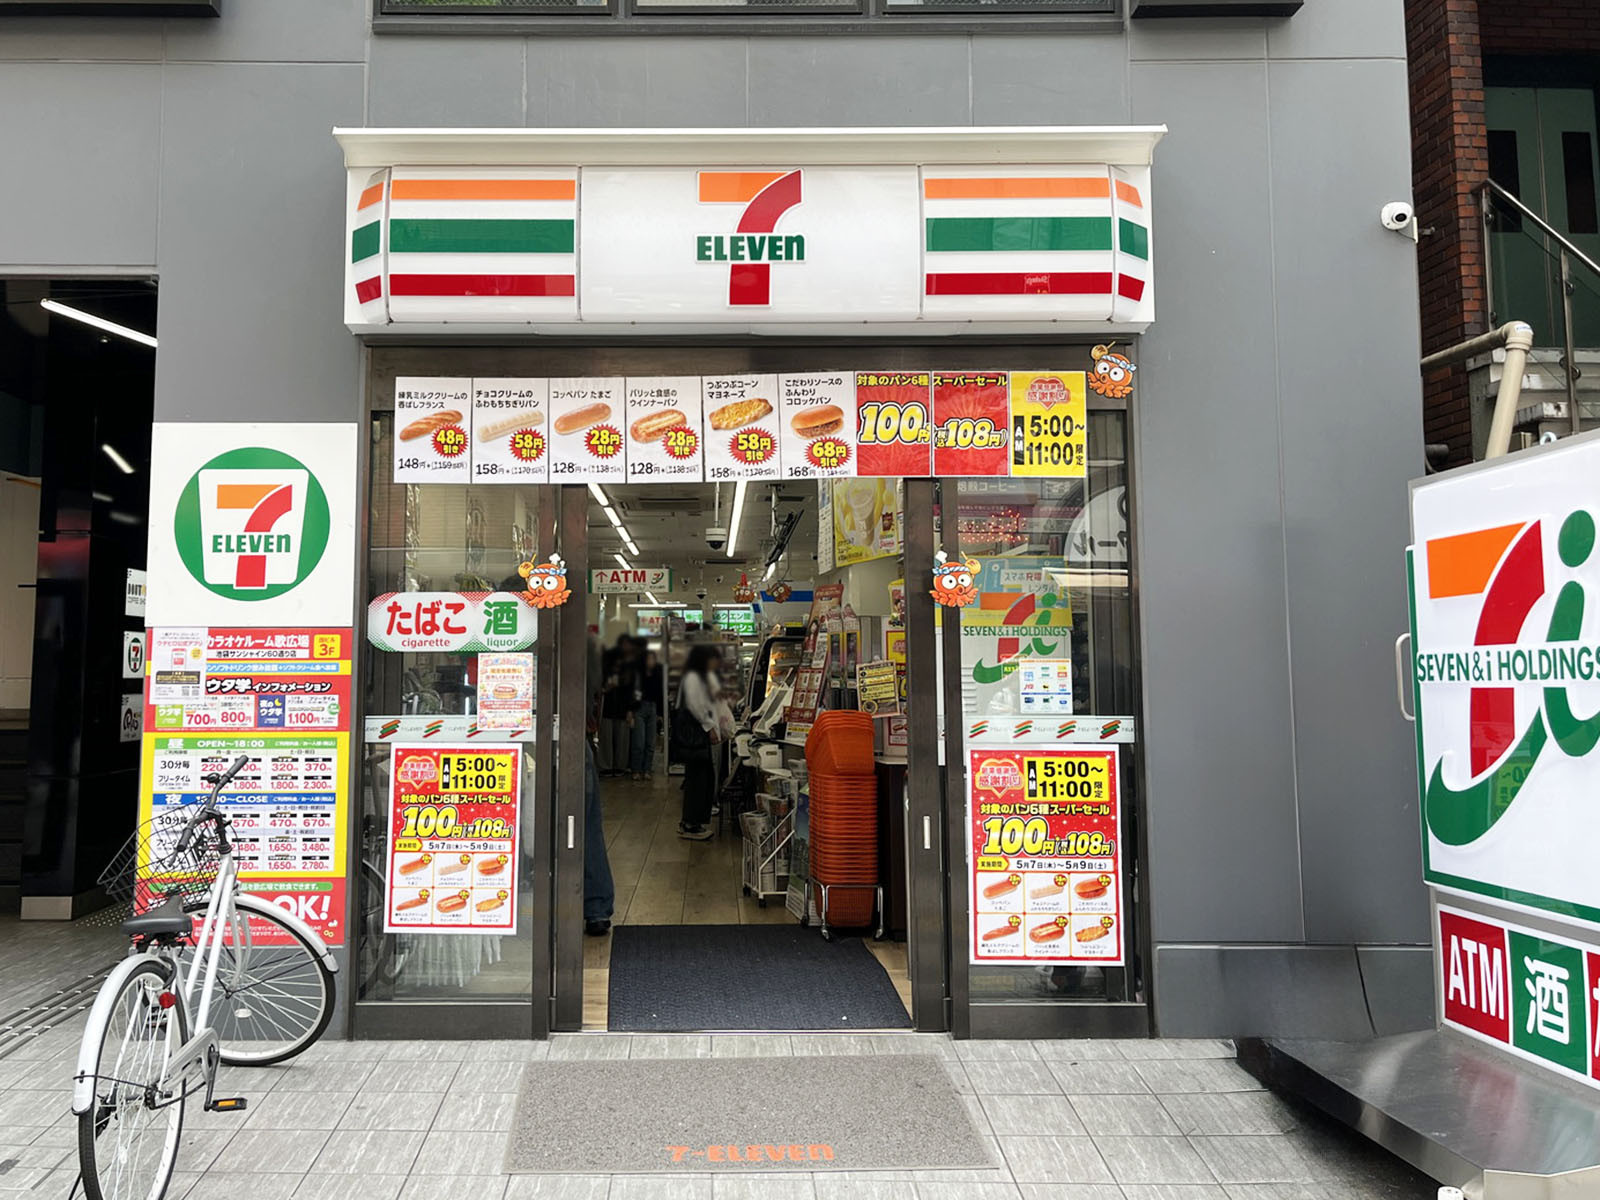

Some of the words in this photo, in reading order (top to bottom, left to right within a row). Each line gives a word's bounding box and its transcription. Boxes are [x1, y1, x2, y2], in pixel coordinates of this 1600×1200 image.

[706, 380, 759, 389] つぶつぶコーン
[785, 378, 843, 387] こだわりソースの
[857, 374, 929, 387] 対象のパン6種
[932, 375, 1007, 387] スーパーセール
[475, 390, 533, 398] チョコクリームの
[552, 390, 588, 399] コッペパン
[590, 390, 612, 399] たまご
[629, 389, 677, 398] パリッと食感の
[707, 390, 746, 398] マヨネーズ
[785, 389, 816, 397] ふんわり
[475, 400, 540, 409] ふわもちちぎりパン
[786, 397, 832, 405] コロッケパン
[858, 402, 930, 443] 100円
[436, 430, 465, 445] 48円
[515, 435, 543, 449] 58円
[590, 429, 620, 445] 28円
[667, 431, 697, 447] 28円
[737, 433, 772, 451] 58円
[443, 445, 459, 454] 引き
[521, 449, 537, 458] 引き
[597, 445, 614, 455] 引き
[674, 447, 690, 456] 引き
[812, 442, 847, 458] 68円
[1026, 442, 1074, 465] 11:00
[1075, 444, 1084, 466] 限定
[745, 450, 765, 461] 引き
[819, 457, 839, 467] 引き
[609, 570, 646, 583] ATM
[386, 600, 467, 636] たばこ
[483, 600, 519, 636] 酒
[1012, 626, 1067, 637] HOLDINGS
[401, 638, 450, 648] cigarette
[486, 638, 519, 648] liquor
[319, 644, 335, 656] 3F
[451, 774, 497, 789] 11:00
[1039, 781, 1092, 798] 11:00
[1448, 934, 1505, 1020] ATM
[1523, 955, 1570, 1045] 酒
